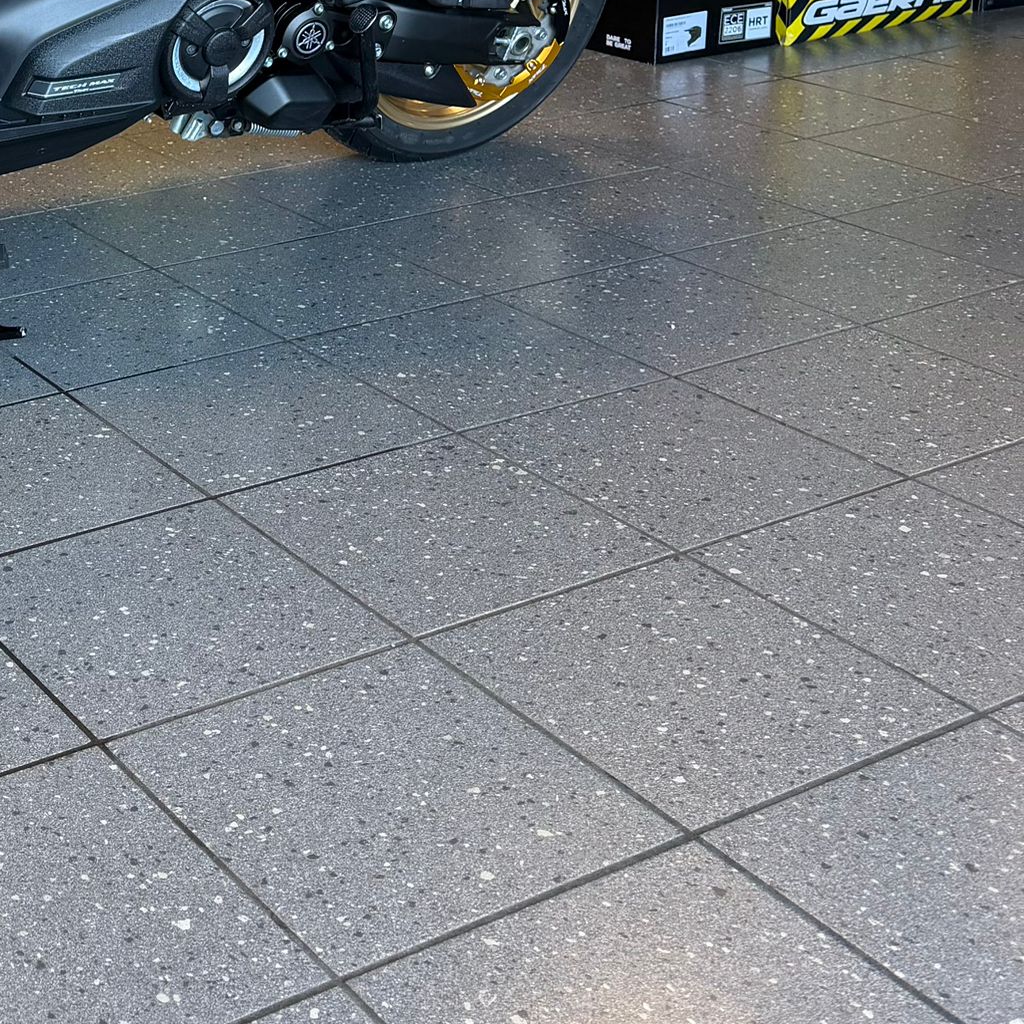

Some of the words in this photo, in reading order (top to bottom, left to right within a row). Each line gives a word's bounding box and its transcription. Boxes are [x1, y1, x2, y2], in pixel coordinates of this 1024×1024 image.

[724, 13, 743, 25] ECE
[748, 16, 768, 27] HRT
[724, 25, 742, 34] 2206
